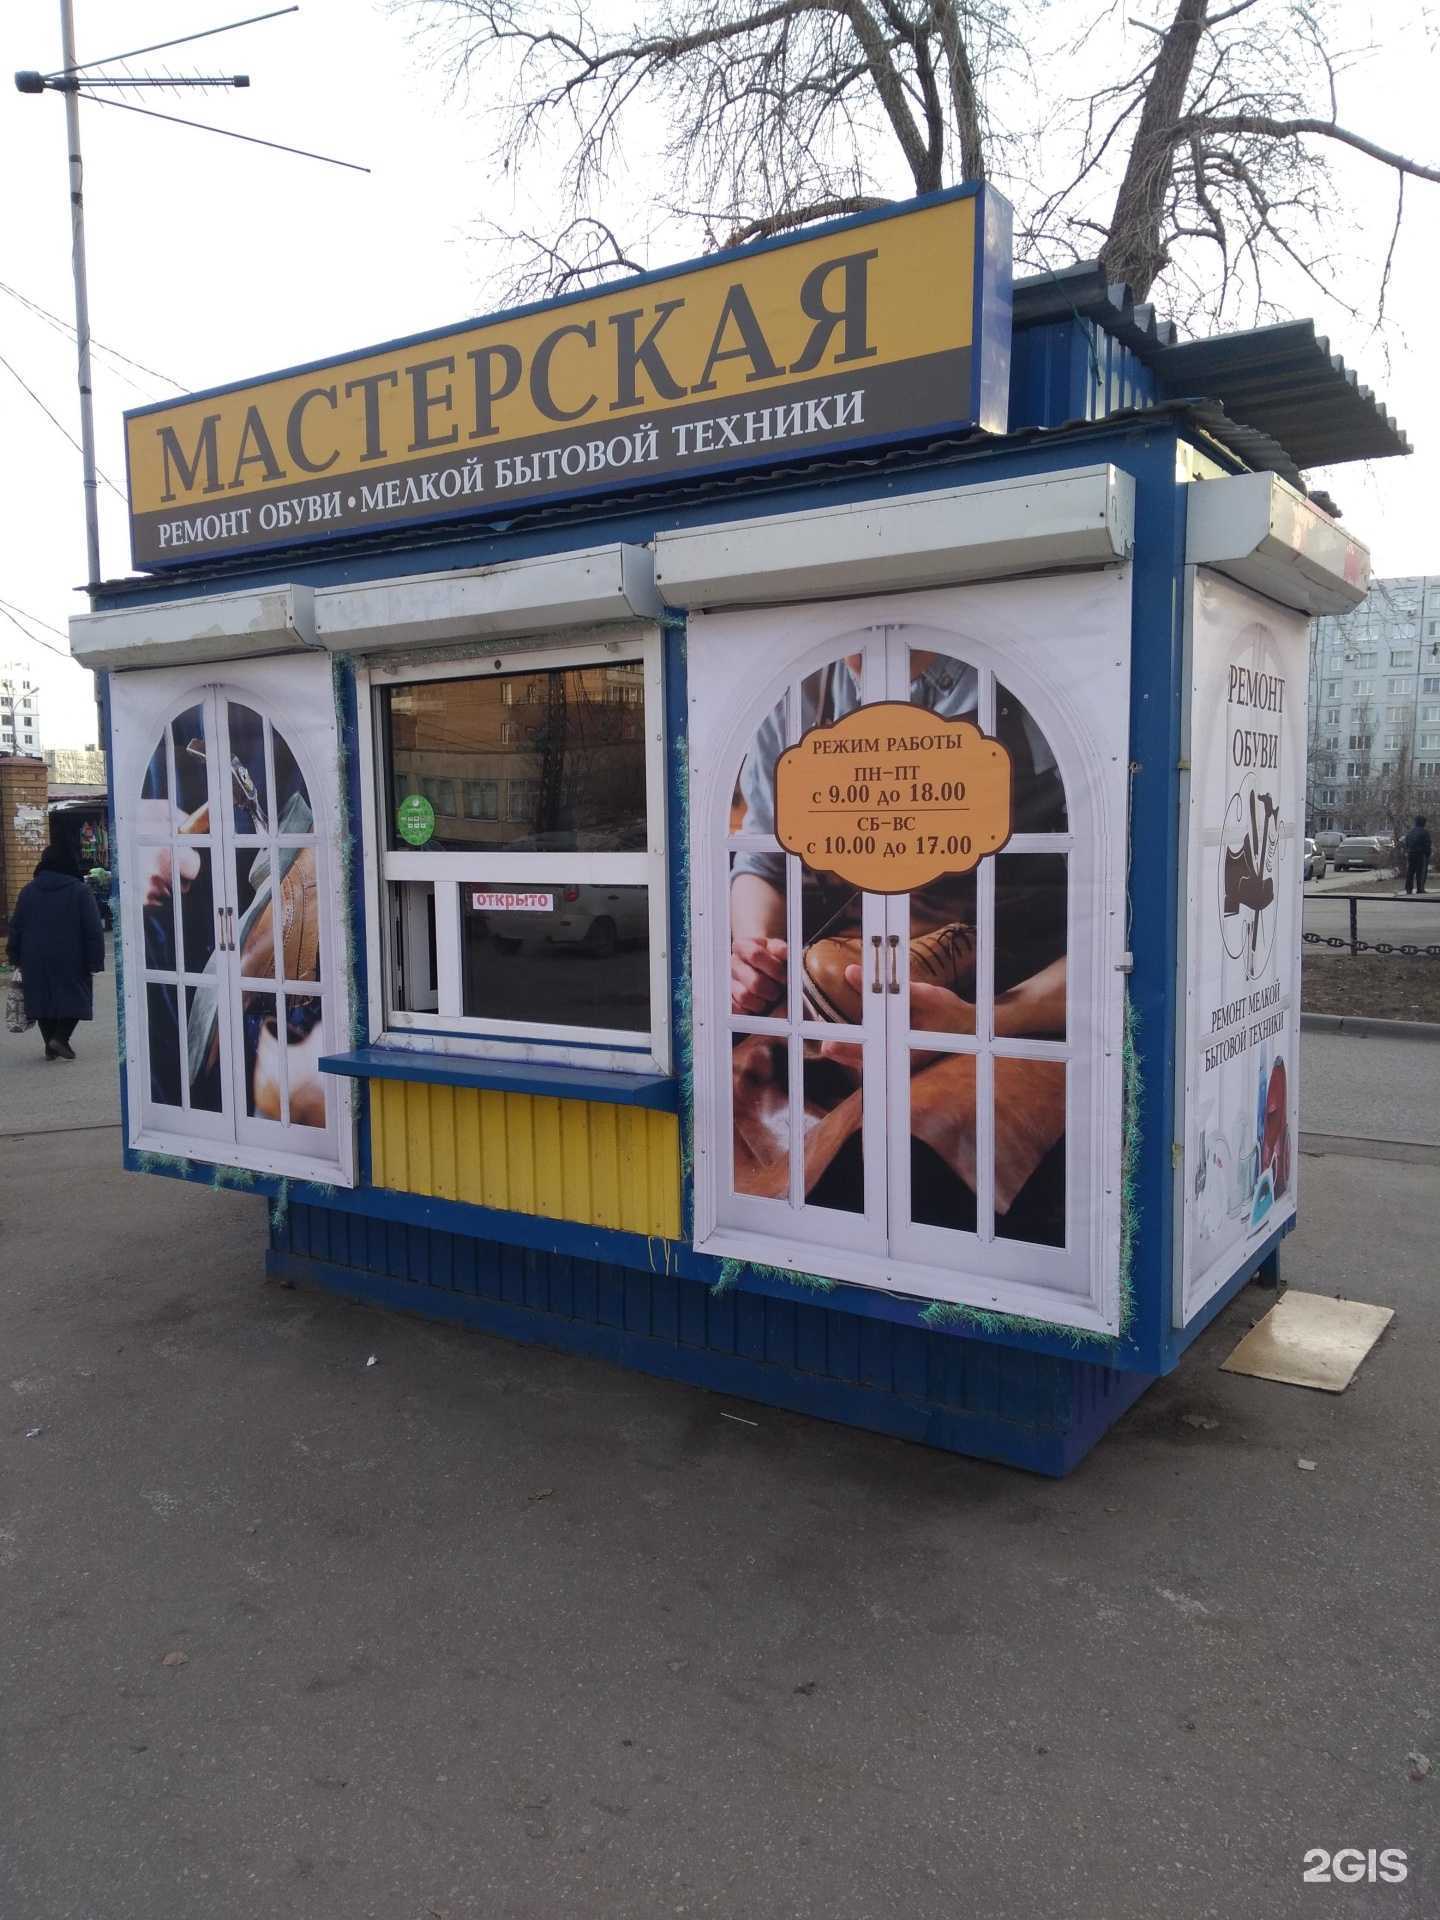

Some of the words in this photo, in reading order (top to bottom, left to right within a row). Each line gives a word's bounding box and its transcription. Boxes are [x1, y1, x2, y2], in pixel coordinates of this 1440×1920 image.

[156, 248, 879, 502] МАСТЕРСКАЯ
[157, 509, 251, 548] РЕМОНТ
[259, 491, 342, 530] ОБУВИ
[360, 457, 484, 512] МЕЛКОЙ
[495, 423, 659, 489] БЫТОВОЙ
[672, 390, 867, 457] ТЕХНИКИ
[1228, 664, 1285, 713] РЕМОНТ
[812, 738, 880, 754] РЕЖИМ
[887, 734, 962, 751] РАБОТЫ
[1233, 729, 1278, 768] ОБУВИ
[854, 765, 920, 781] ПН-ПТ
[829, 785, 869, 803] 9.00
[877, 790, 900, 806] до
[910, 782, 966, 801] 18.00
[857, 816, 916, 831] СБ-ВС
[825, 836, 875, 854] 10.00
[883, 841, 906, 857] до
[916, 836, 971, 854] 17.00
[1211, 998, 1247, 1033] РЕМОНТ
[1248, 978, 1281, 1016] МЕЛКОЙ
[1205, 1026, 1247, 1072] БЫТОВОЙ
[1249, 1011, 1284, 1047] ТЕХНИКИ
